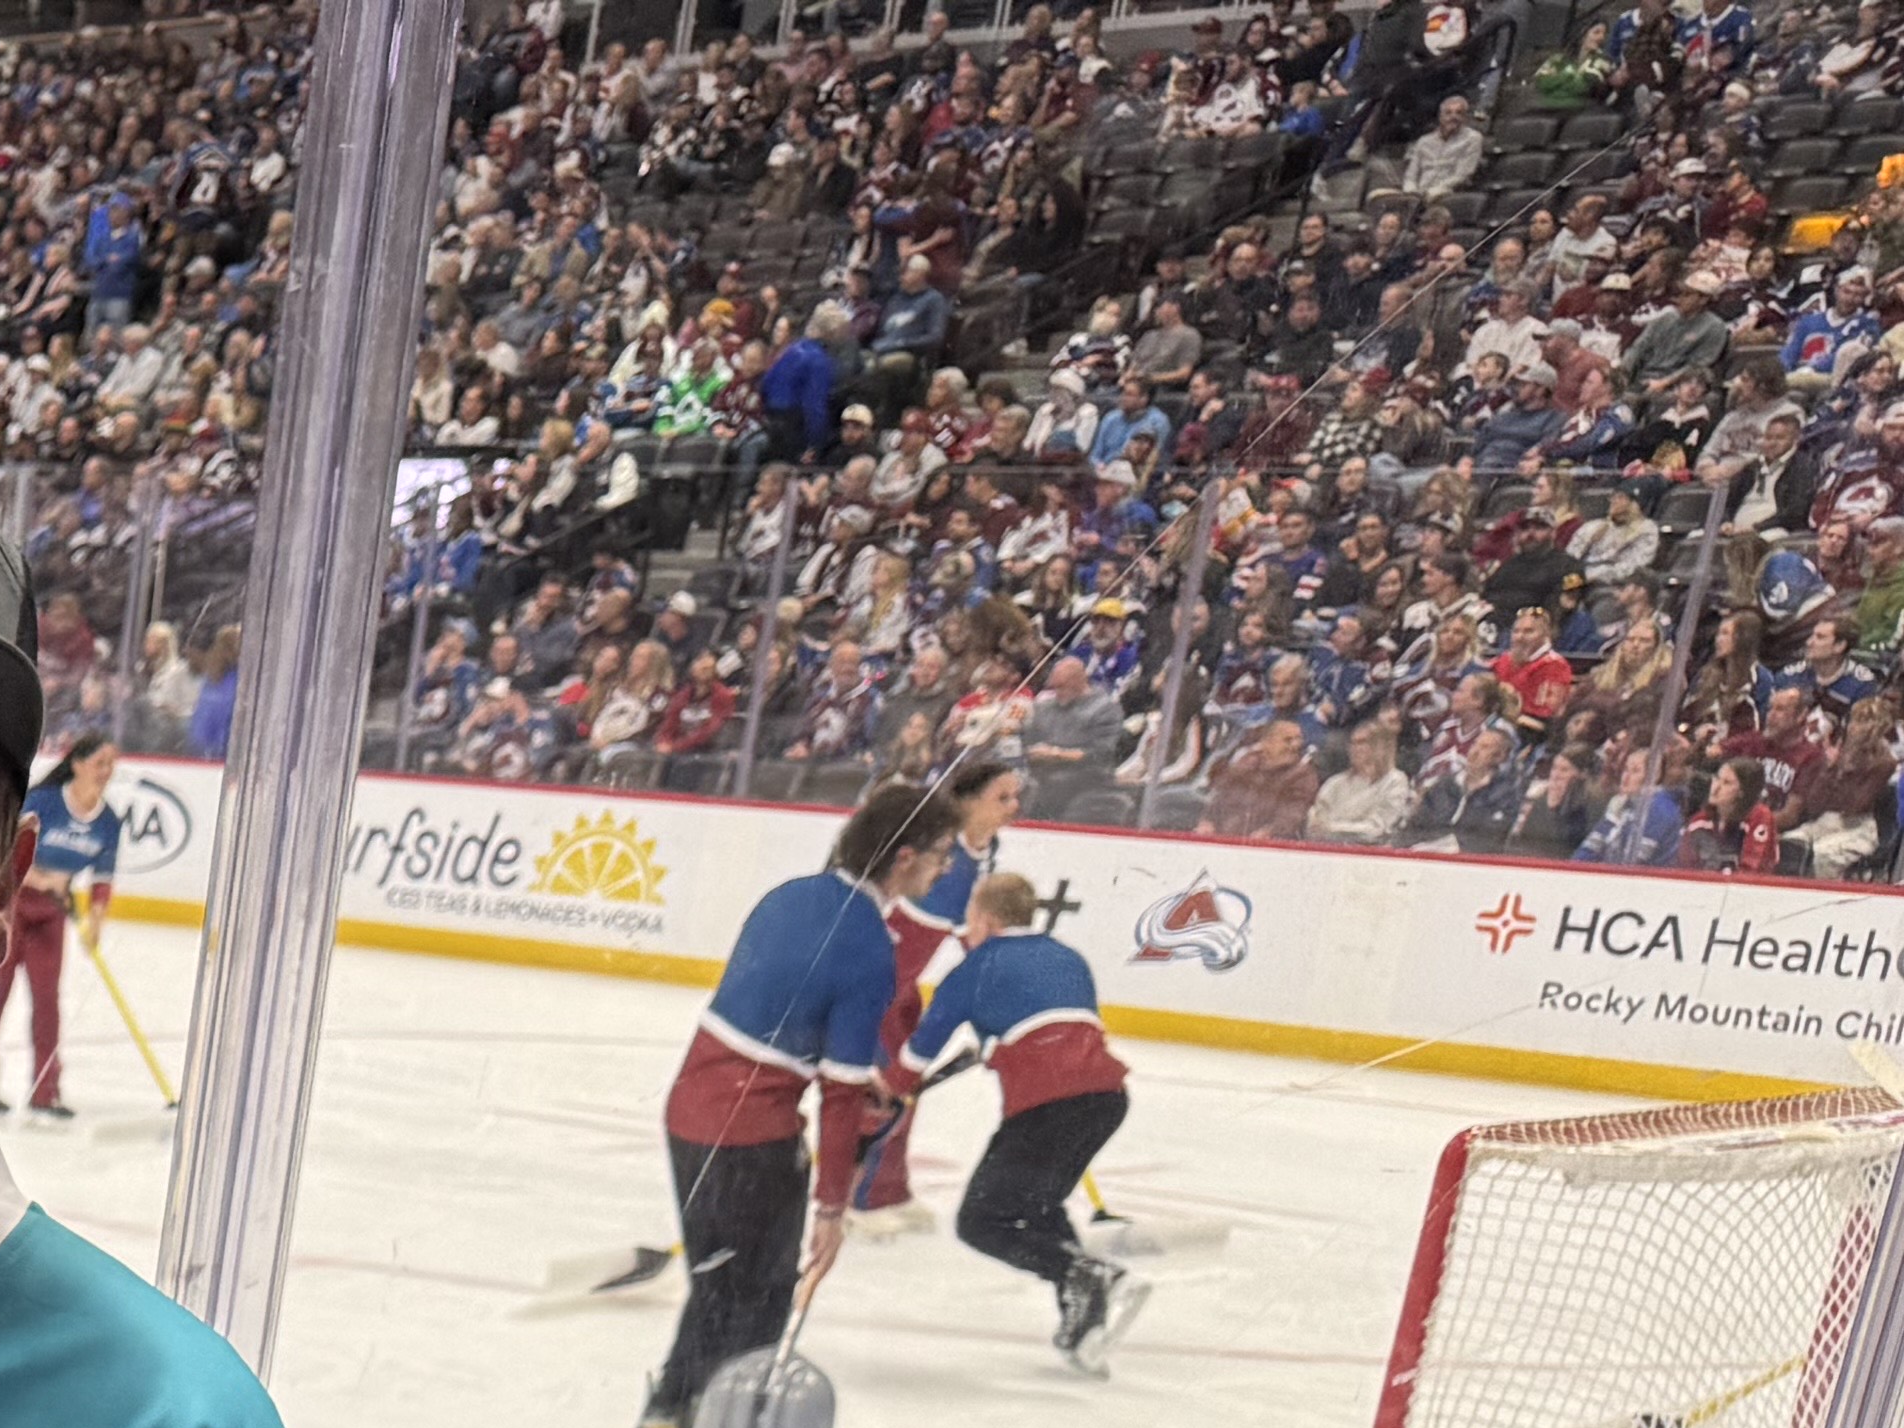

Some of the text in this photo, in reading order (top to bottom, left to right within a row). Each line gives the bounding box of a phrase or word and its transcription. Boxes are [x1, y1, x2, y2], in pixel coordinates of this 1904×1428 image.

[1553, 905, 1684, 962] HCA
[1538, 981, 1646, 1025] Rocky
[1653, 992, 1823, 1037] Mountain
